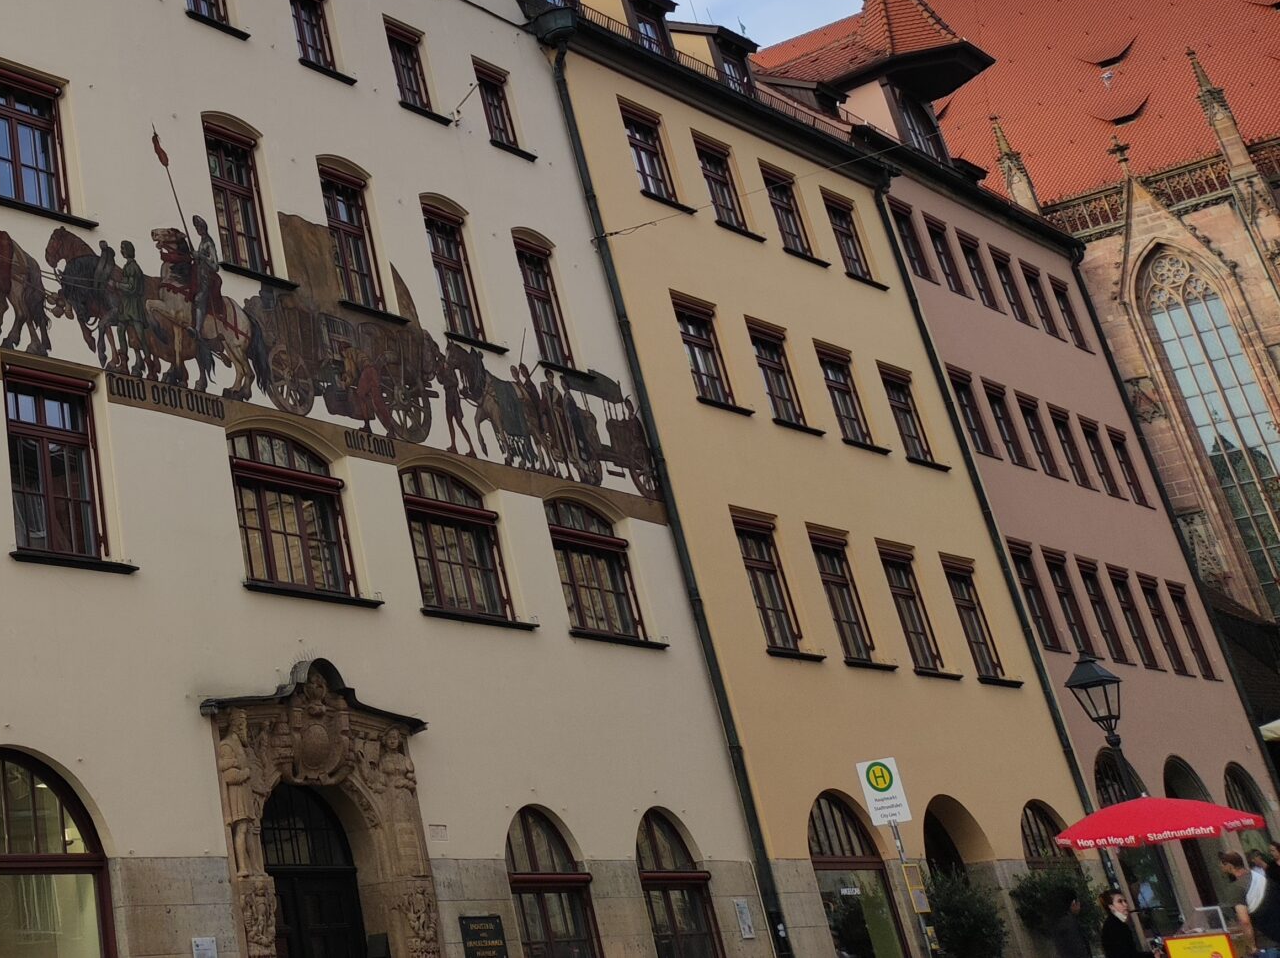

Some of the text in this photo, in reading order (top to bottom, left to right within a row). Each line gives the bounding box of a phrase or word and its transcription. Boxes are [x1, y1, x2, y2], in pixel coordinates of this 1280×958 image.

[152, 383, 184, 410] geht
[186, 389, 225, 421] durch
[1077, 838, 1095, 848] Hop
[1096, 838, 1107, 846] on
[1108, 836, 1125, 846] Hop
[1125, 835, 1136, 844] off
[1147, 825, 1215, 842] Stadtrundfahrt
